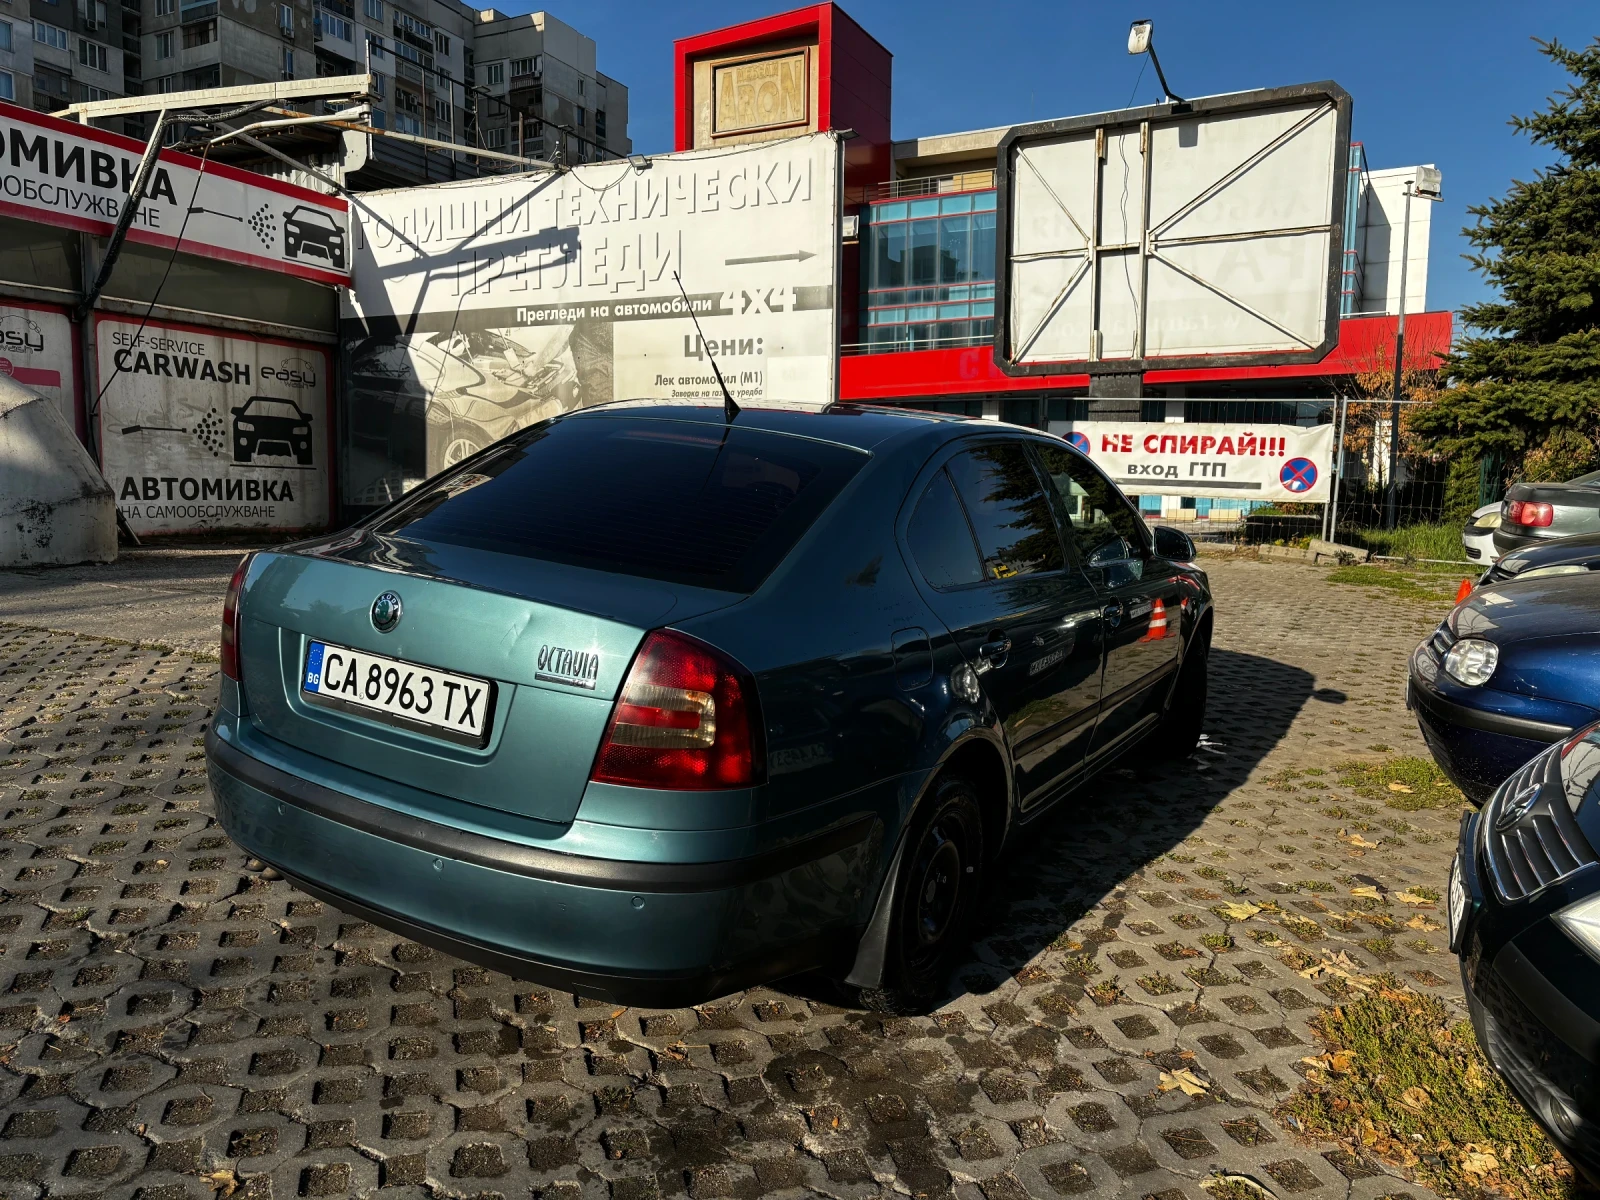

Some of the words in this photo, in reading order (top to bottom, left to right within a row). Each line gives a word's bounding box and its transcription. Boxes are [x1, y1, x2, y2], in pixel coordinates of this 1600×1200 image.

[717, 59, 802, 131] ARON
[0, 126, 178, 206] МИВКА
[355, 193, 530, 254] ГОДИШНИ
[543, 157, 812, 228] ТЕХНИЧЕСКИ
[451, 229, 682, 297] ПРЕГЛЕДИ
[516, 307, 586, 325] Прегледи
[590, 305, 609, 318] на
[614, 297, 712, 317] автомобили
[112, 332, 205, 356] SELF-SERVICE
[684, 334, 763, 361] Цени:
[114, 349, 250, 385] CARWASH
[260, 366, 316, 388] easy
[654, 375, 675, 386] Лек
[701, 390, 710, 398] на
[737, 386, 763, 398] уредба
[1101, 433, 1133, 453] НЕ
[1143, 431, 1286, 457] СПИРАЙ!!!
[1127, 463, 1178, 479] вход
[1188, 461, 1227, 478] ГТП
[120, 476, 294, 501] АВТОМИВКА
[120, 505, 141, 518] НА
[146, 505, 275, 519] САМООБСЛУЖВАНЕ
[537, 644, 599, 681] OCTAVIA
[307, 672, 319, 685] BG
[324, 653, 358, 696] CA
[364, 663, 434, 714] 8963
[442, 680, 482, 729] TX
